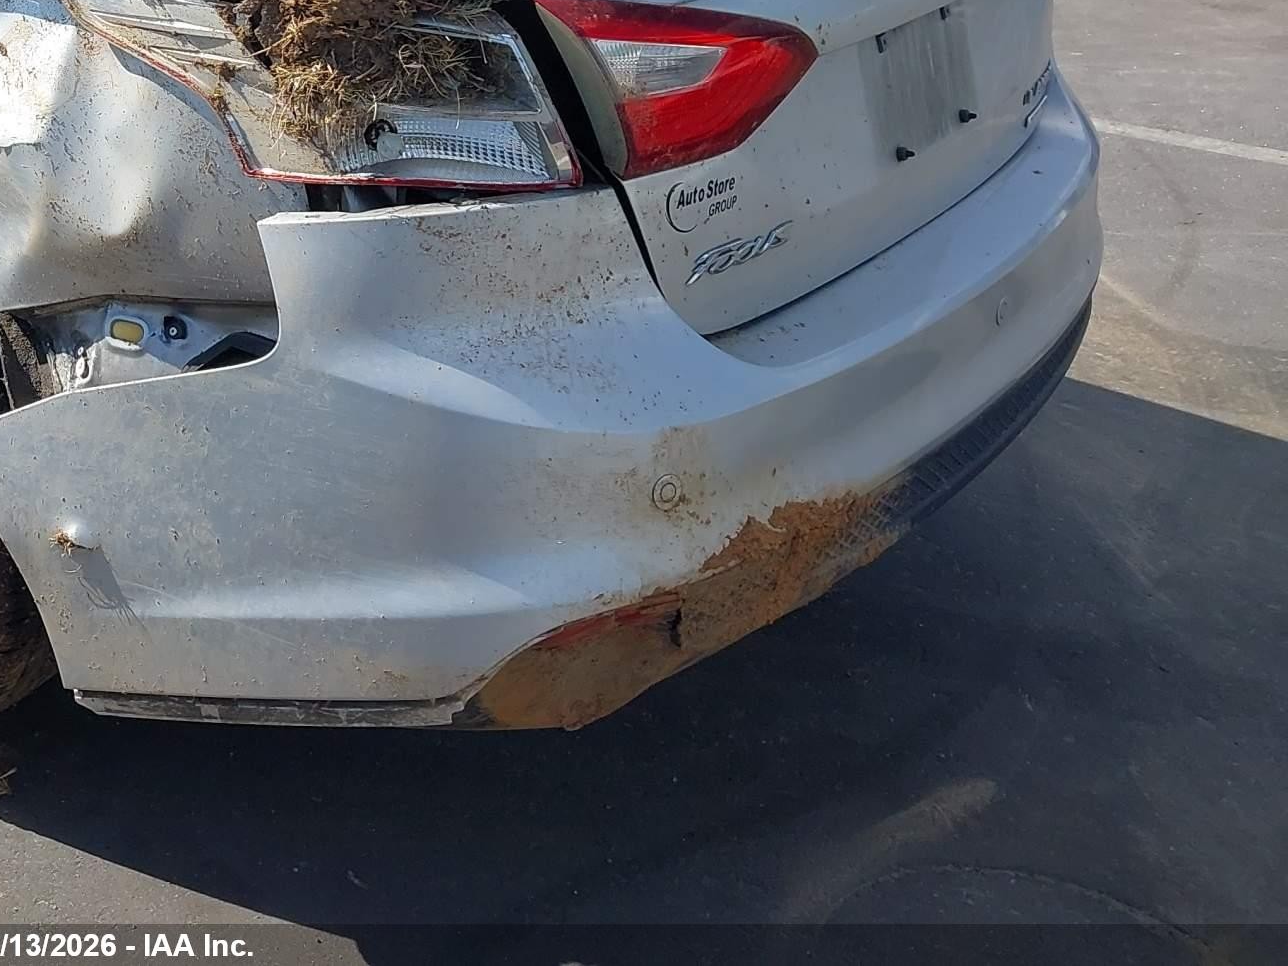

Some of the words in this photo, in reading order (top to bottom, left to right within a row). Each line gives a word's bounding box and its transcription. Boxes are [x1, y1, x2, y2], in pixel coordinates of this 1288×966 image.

[676, 188, 705, 209] Auto
[707, 176, 736, 199] Store
[708, 195, 738, 216] GROUP
